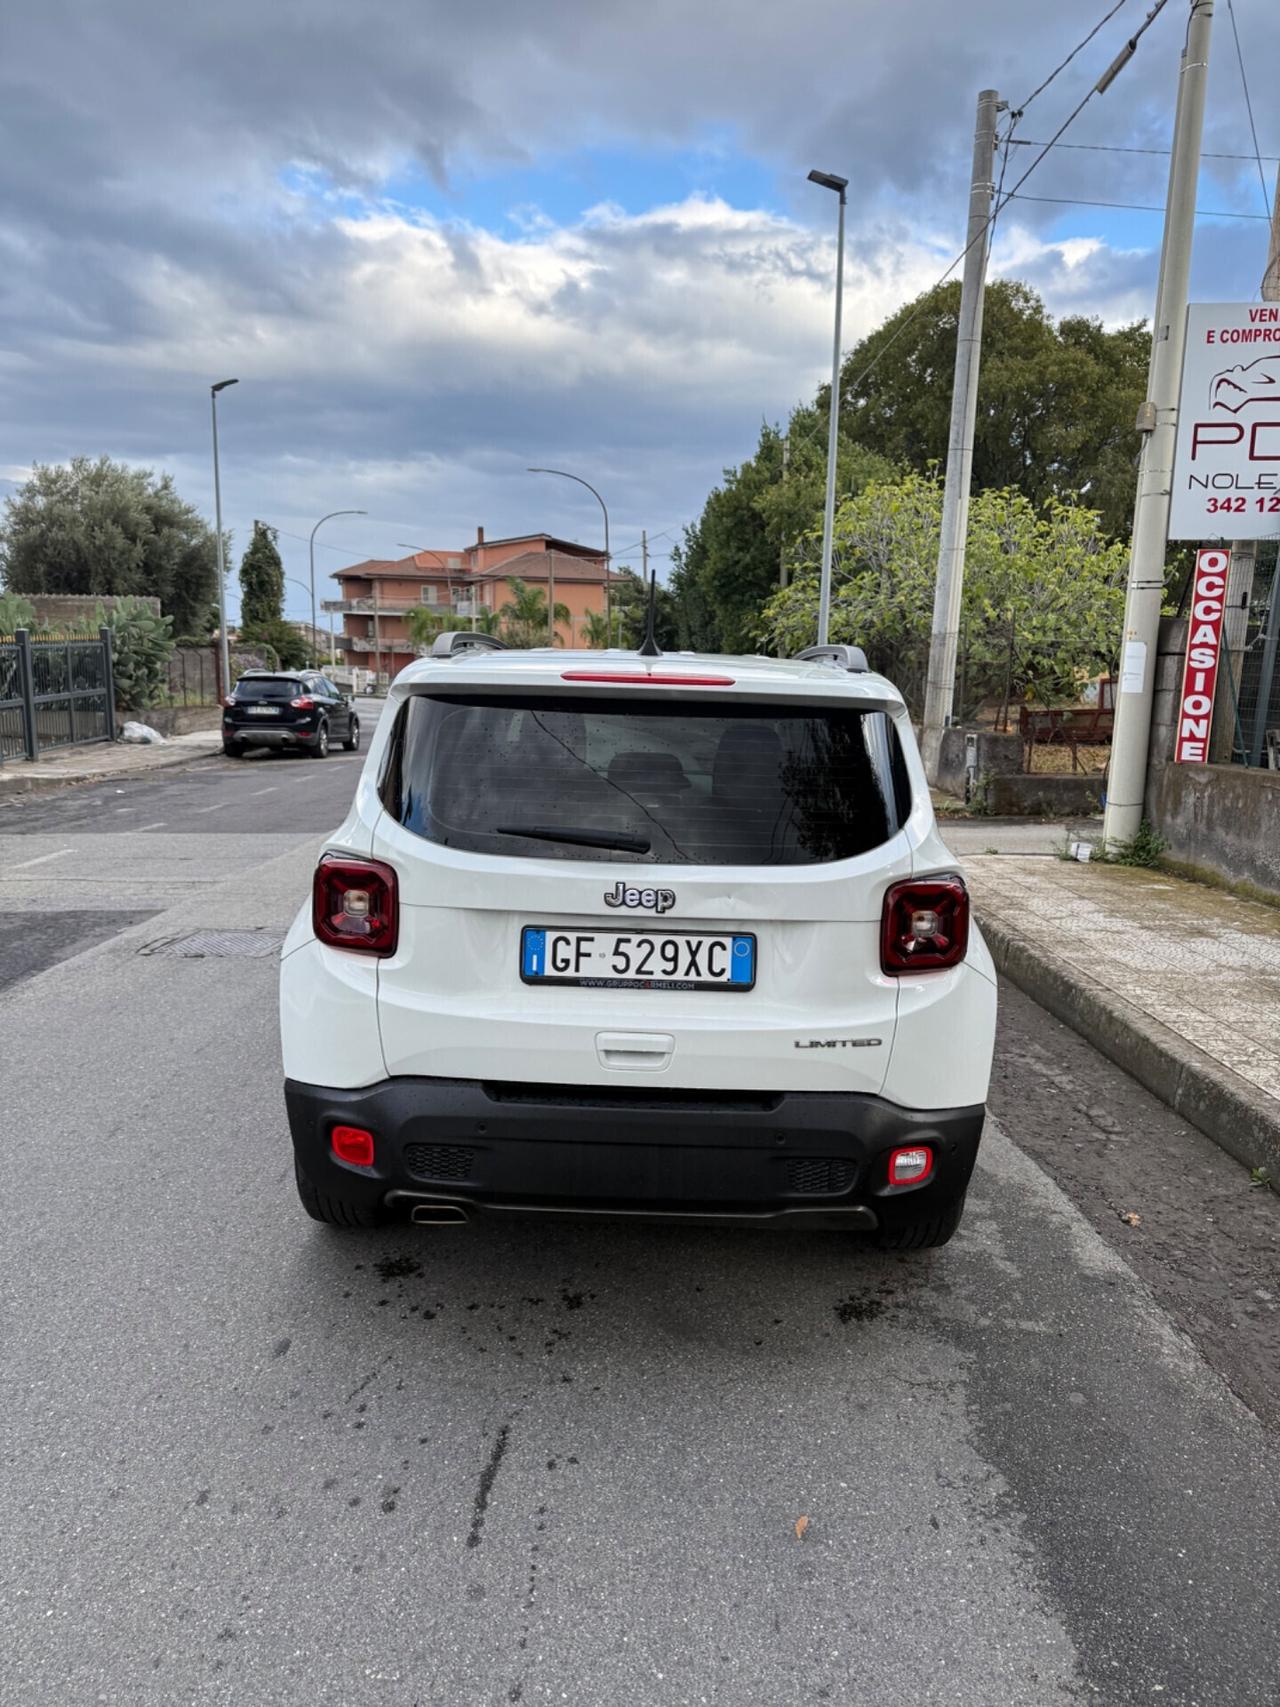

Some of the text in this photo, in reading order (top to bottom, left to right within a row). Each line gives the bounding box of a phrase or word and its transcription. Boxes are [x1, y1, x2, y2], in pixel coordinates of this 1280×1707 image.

[1206, 330, 1215, 343] E
[1188, 473, 1280, 492] NOLE
[1206, 497, 1280, 513] 342 12
[1181, 551, 1228, 762] OCCASIONE
[604, 882, 676, 914] Jeep
[551, 936, 727, 977] GF 529XC
[794, 1039, 882, 1048] LIMITED
